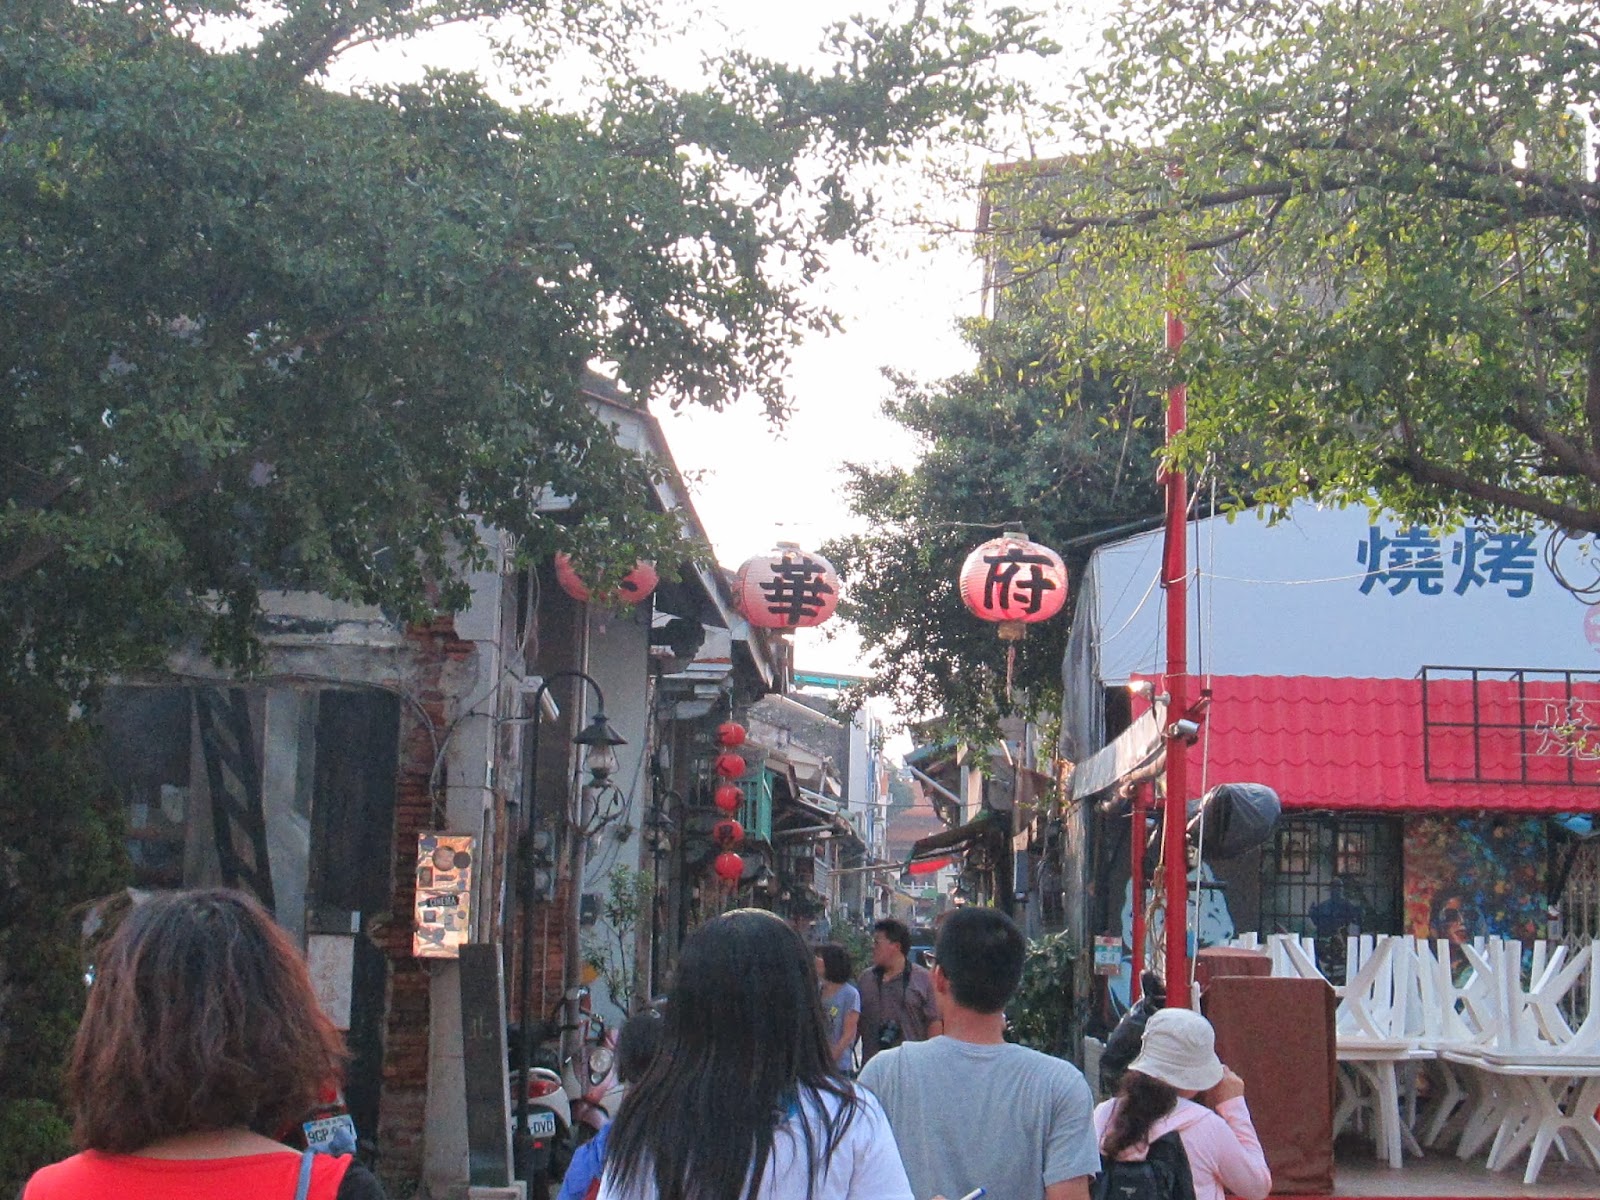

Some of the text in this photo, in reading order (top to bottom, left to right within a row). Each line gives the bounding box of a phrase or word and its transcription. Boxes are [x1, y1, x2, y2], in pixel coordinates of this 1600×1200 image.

[758, 555, 835, 625] 華
[983, 548, 1057, 614] 府
[1356, 525, 1538, 598] 燒烤
[428, 895, 457, 907] CINEMA
